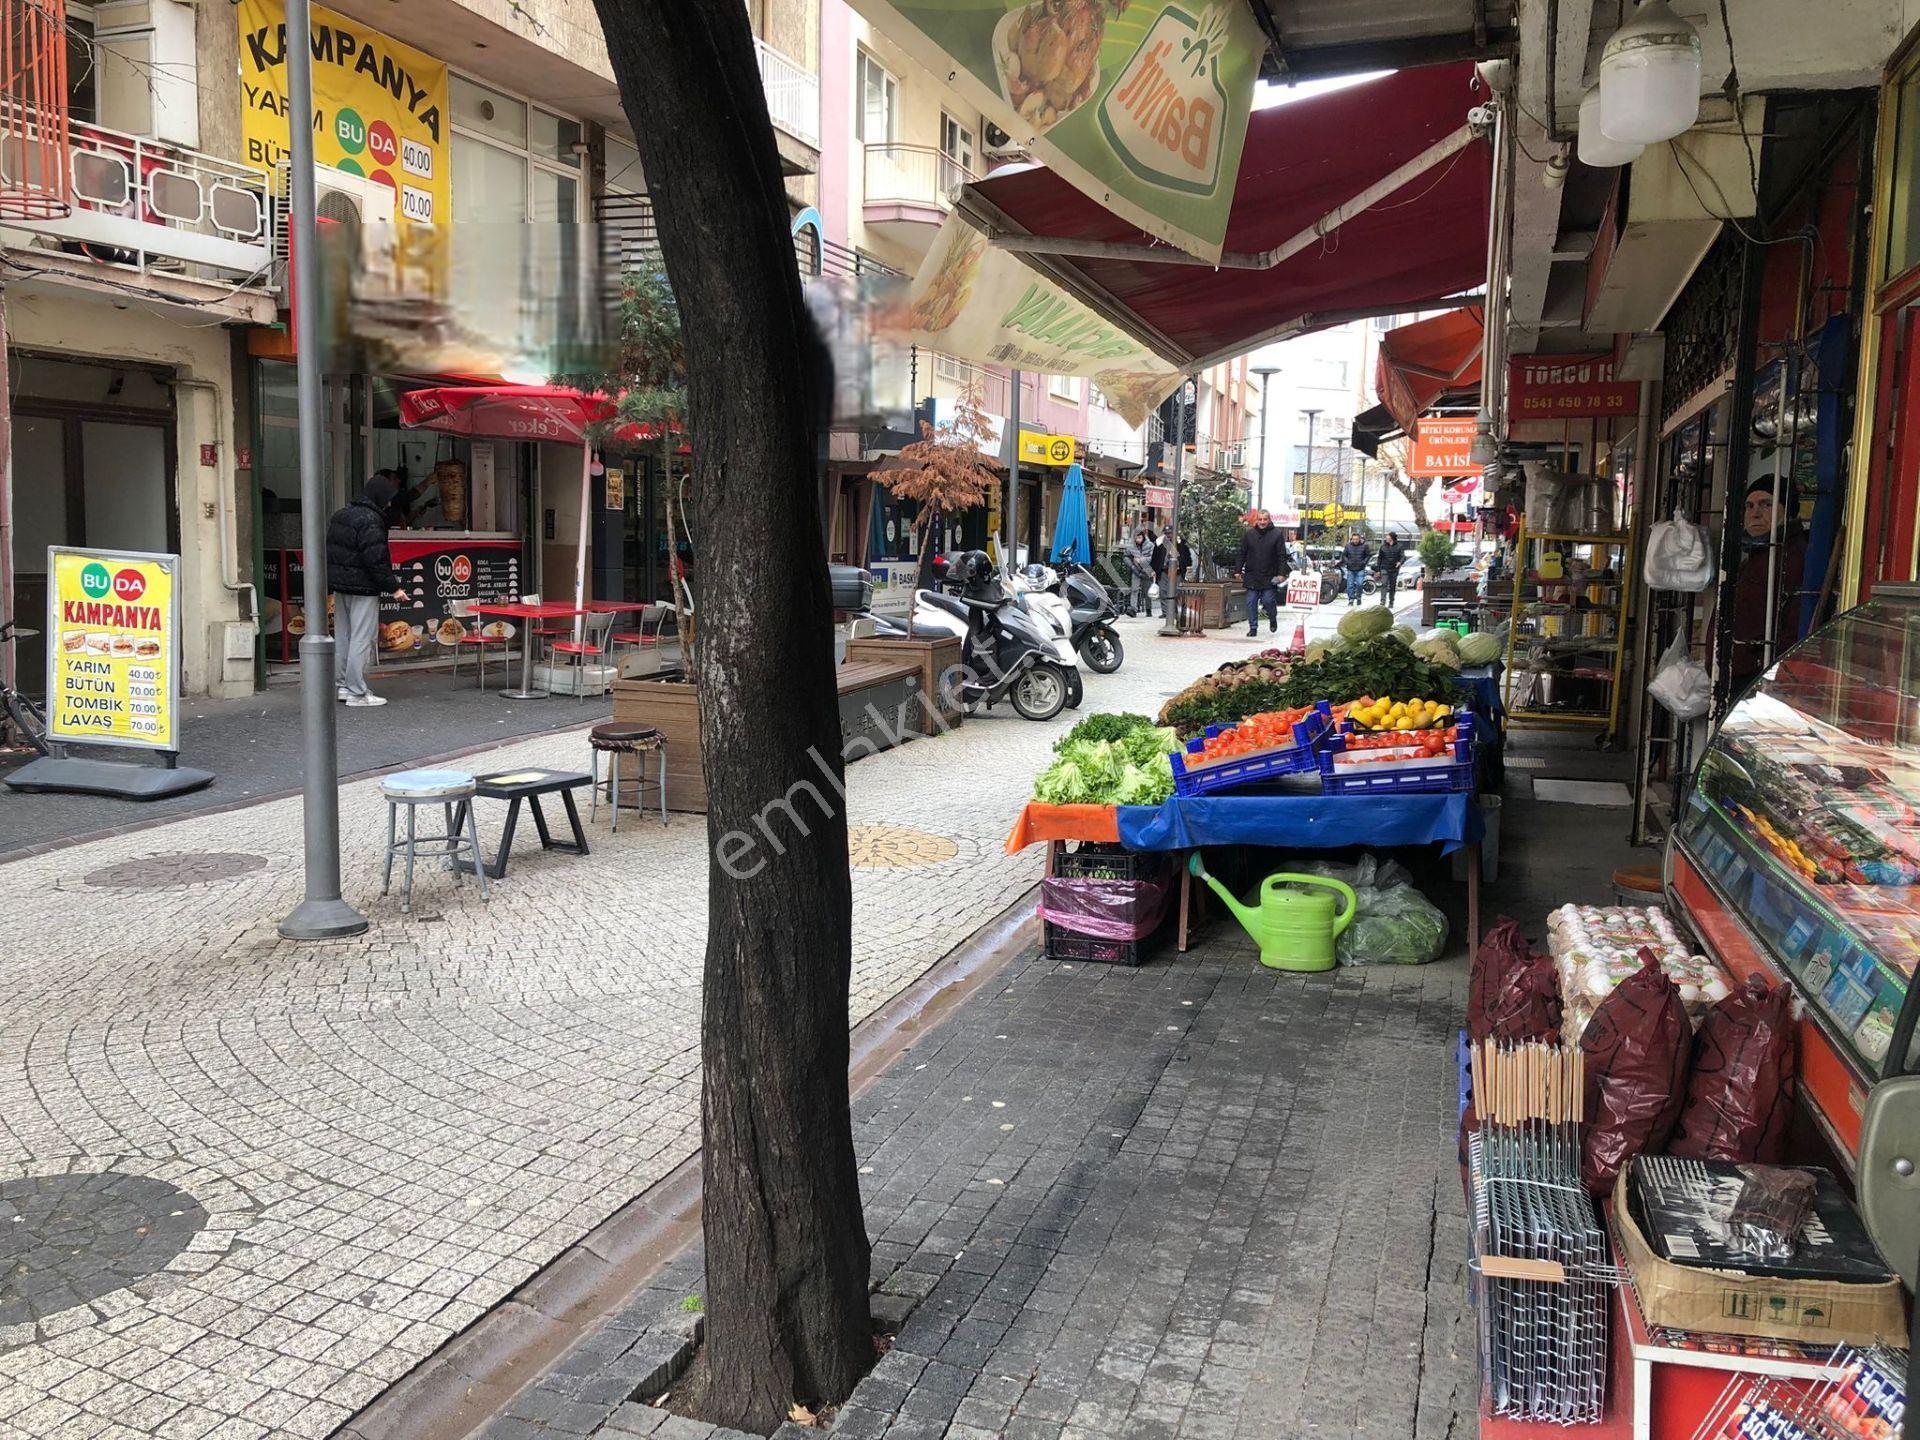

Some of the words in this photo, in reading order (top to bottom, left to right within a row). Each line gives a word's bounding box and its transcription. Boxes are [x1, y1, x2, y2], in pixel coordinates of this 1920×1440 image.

[243, 81, 323, 132] YARM
[338, 122, 363, 143] BU
[370, 131, 396, 157] DA
[402, 149, 430, 172] 40.00
[402, 191, 431, 217] 70.00
[1425, 452, 1472, 468] BAYİSİ
[437, 562, 451, 576] bu
[455, 562, 469, 576] da
[83, 574, 108, 589] BU
[115, 577, 145, 593] DA
[436, 581, 470, 598] döner
[1289, 591, 1318, 604] TARIM
[64, 600, 162, 632] KAMPANYA
[65, 659, 112, 675] YARIM
[65, 677, 116, 693] BÜTÜN
[65, 695, 124, 712] TOMBİK
[62, 713, 113, 728] LAVAŞ
